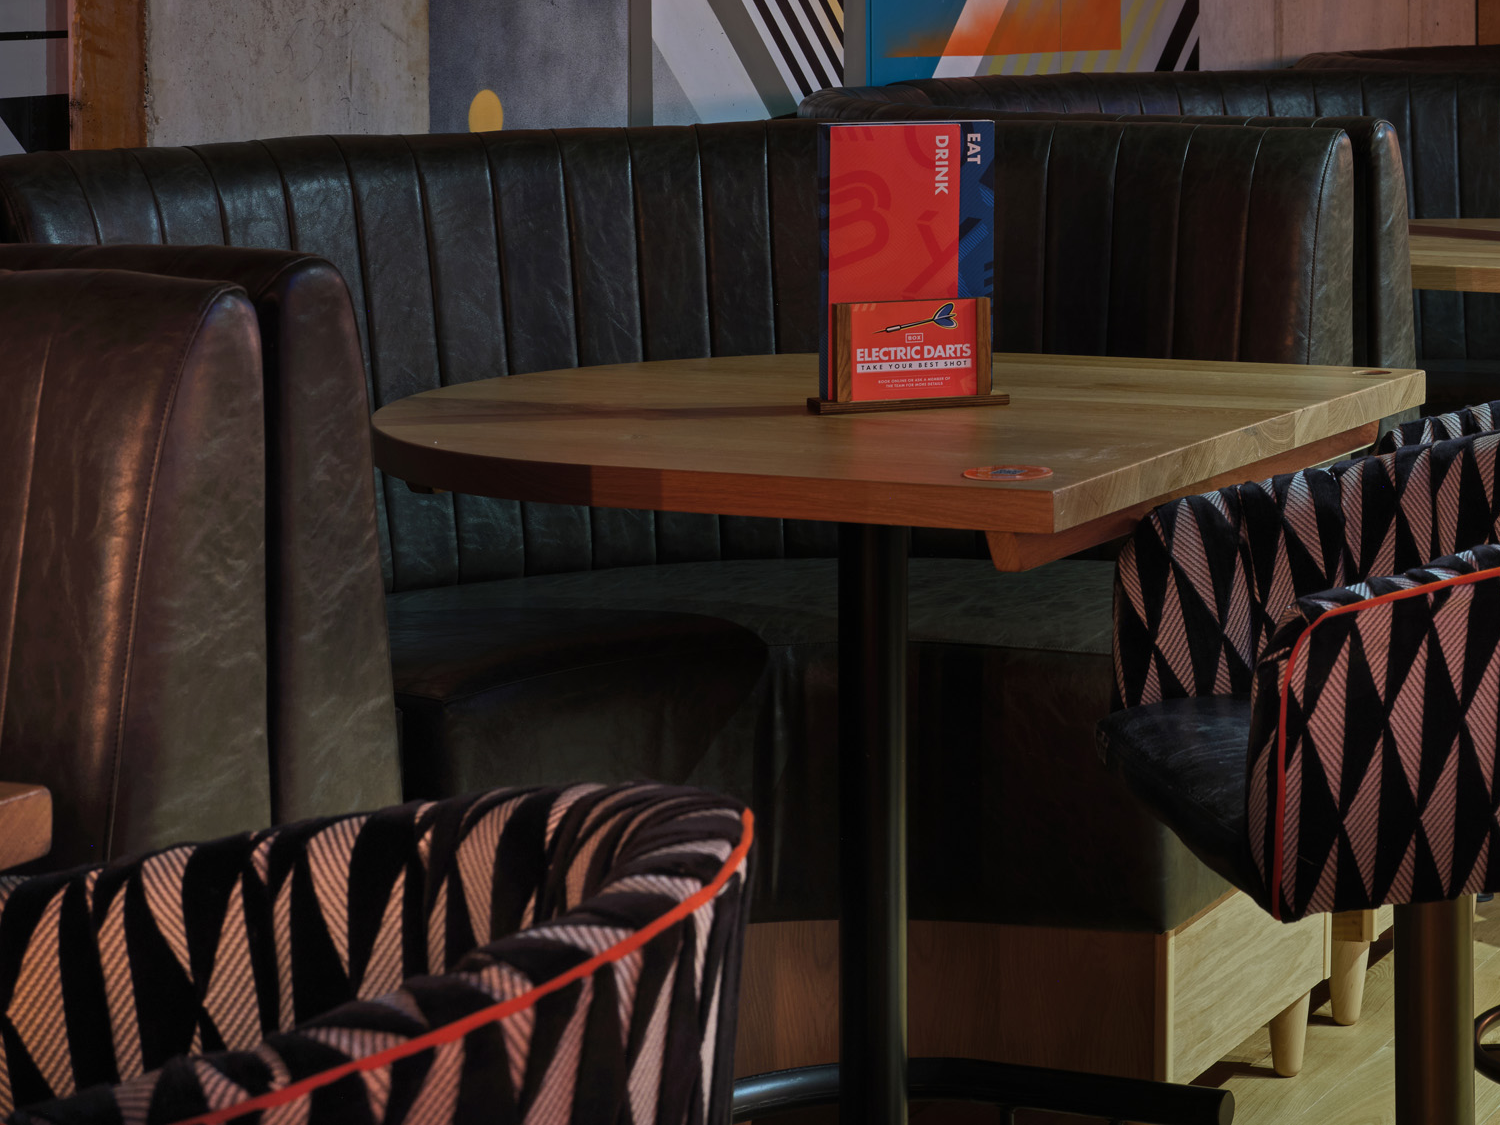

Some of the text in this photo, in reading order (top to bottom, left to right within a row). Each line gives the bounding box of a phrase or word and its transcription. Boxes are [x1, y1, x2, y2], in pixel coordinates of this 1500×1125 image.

[967, 133, 981, 165] EAT
[935, 135, 949, 196] DRINK
[857, 343, 972, 362] ELECTRIC DARTS
